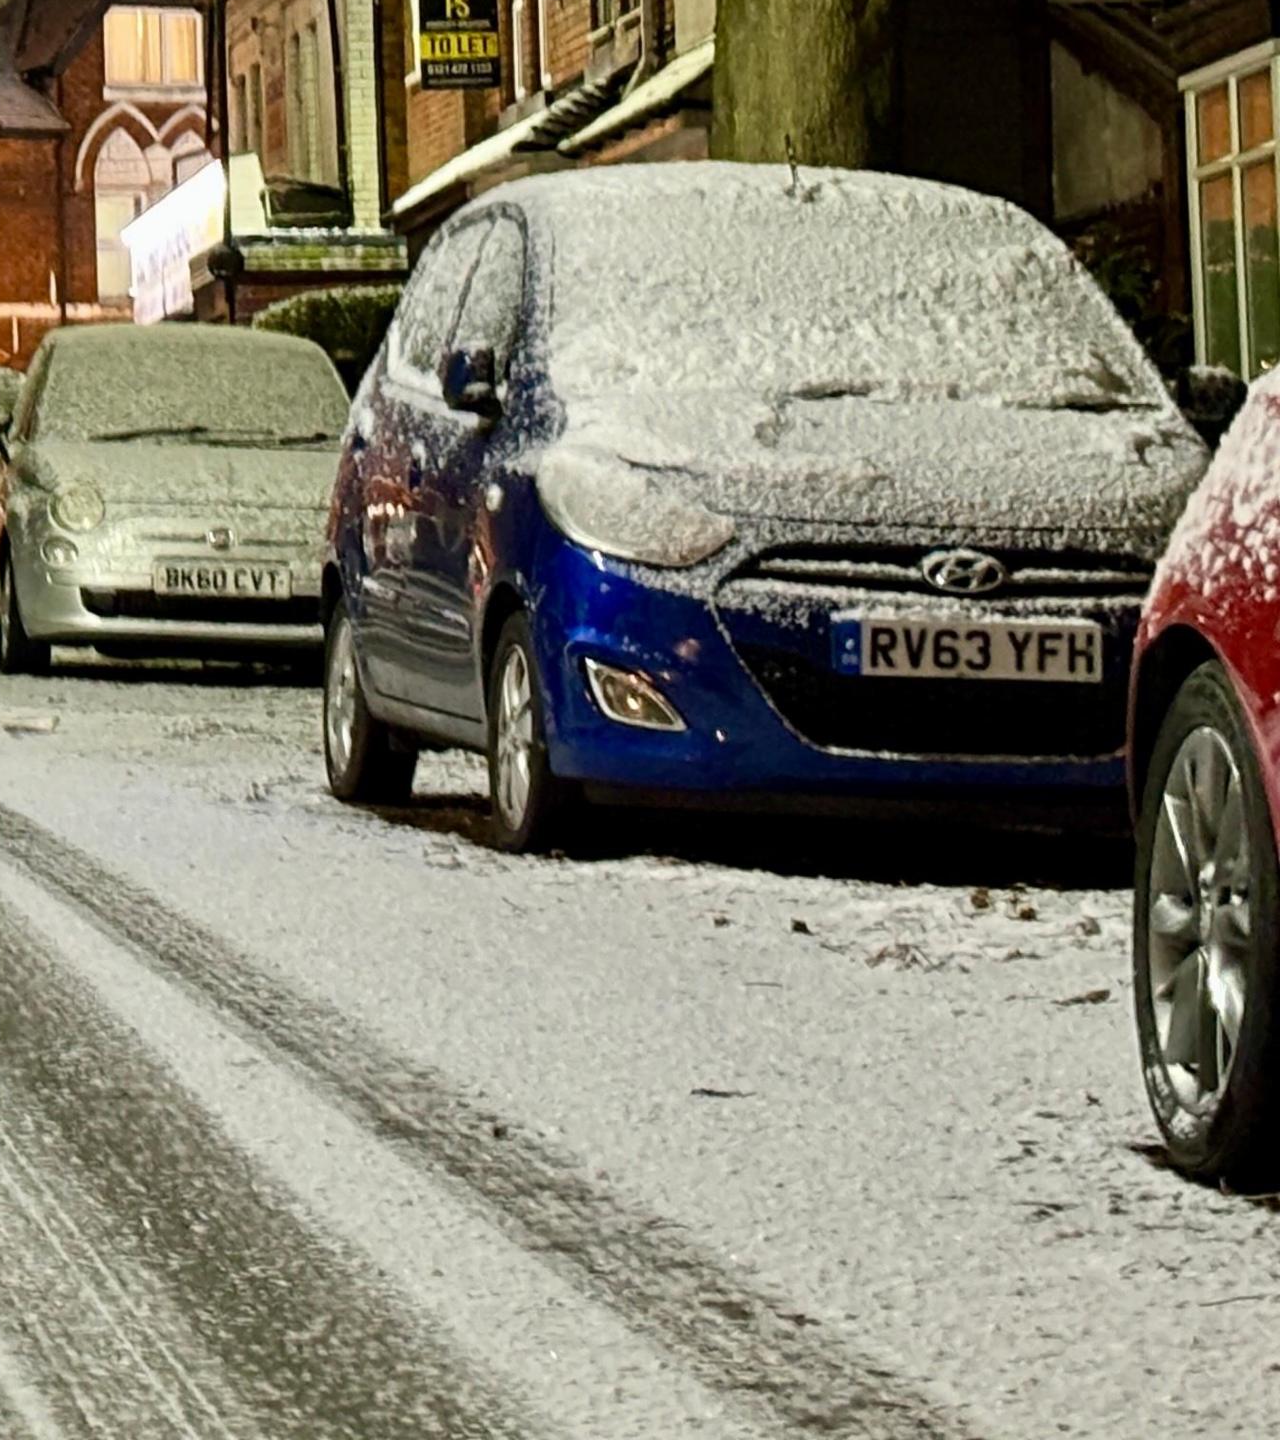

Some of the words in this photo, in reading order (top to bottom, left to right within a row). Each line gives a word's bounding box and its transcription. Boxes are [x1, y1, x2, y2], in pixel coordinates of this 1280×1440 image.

[429, 34, 451, 55] TO
[456, 34, 490, 54] LET
[869, 626, 991, 671] RV63
[1006, 630, 1095, 675] YFH
